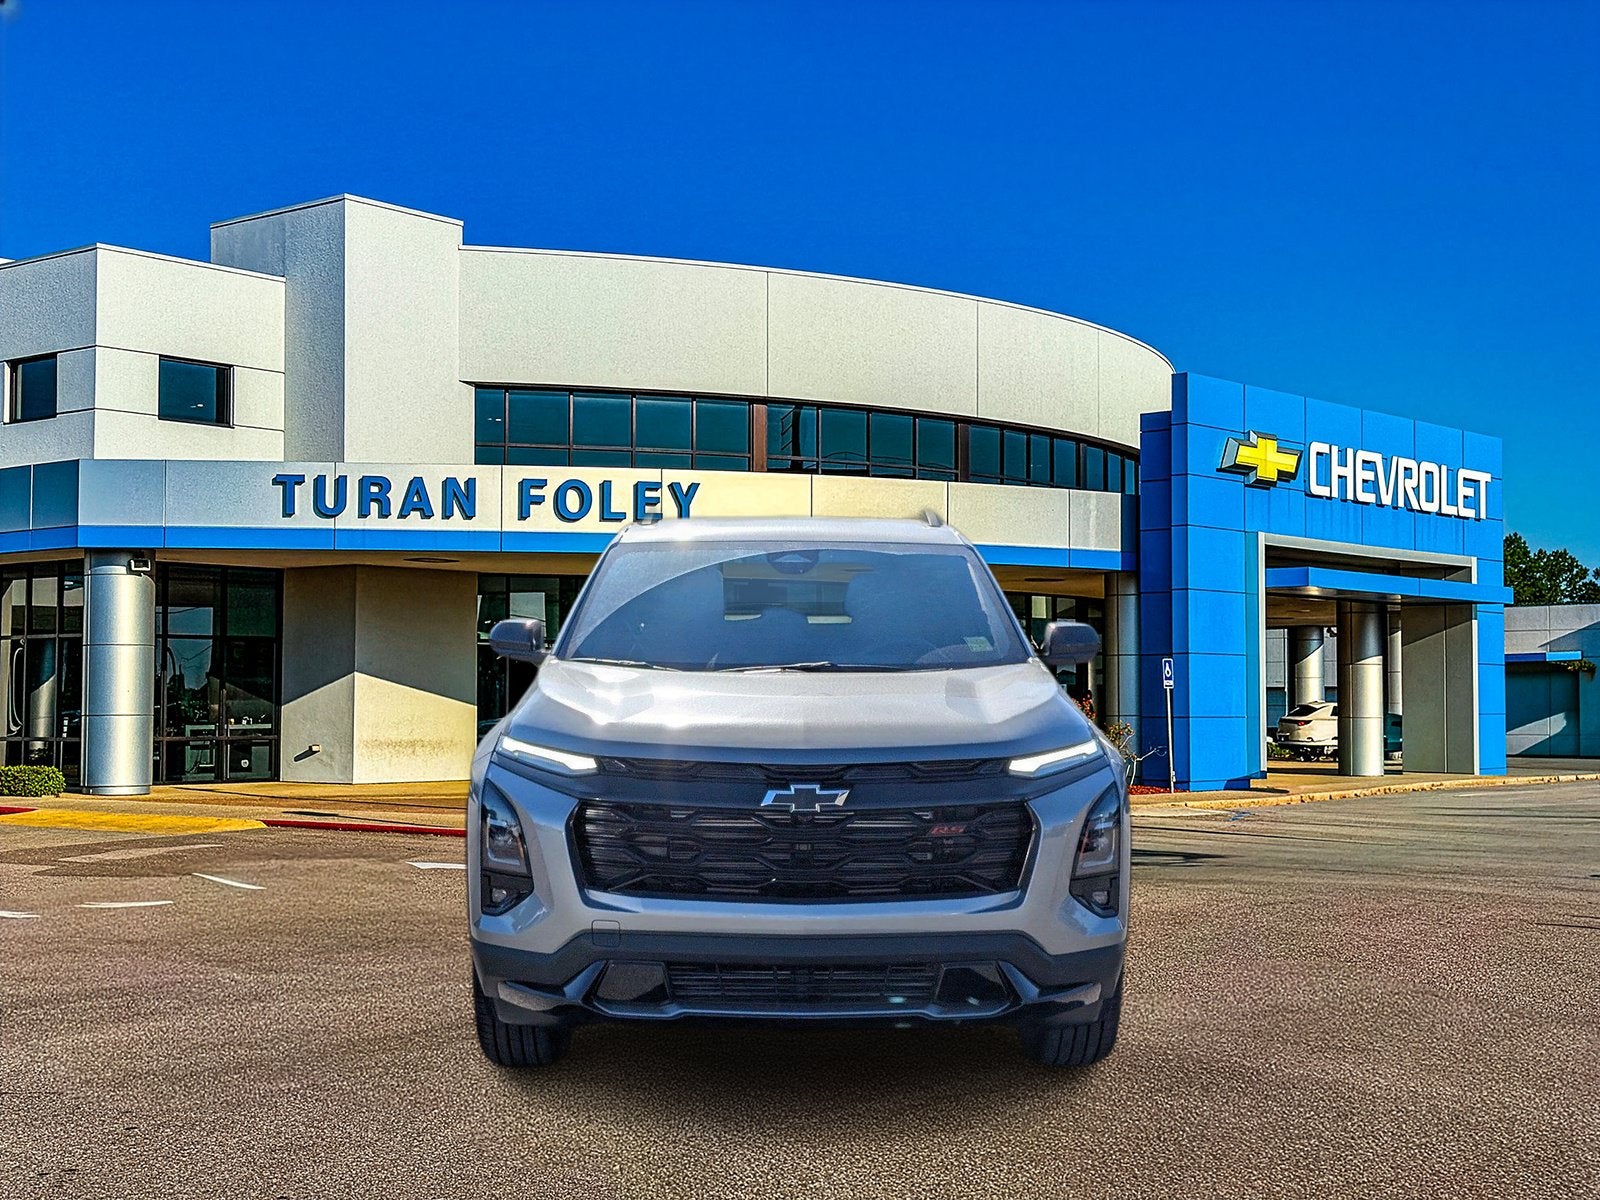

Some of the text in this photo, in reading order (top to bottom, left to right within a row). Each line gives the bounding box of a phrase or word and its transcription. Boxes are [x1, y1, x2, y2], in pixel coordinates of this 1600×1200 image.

[272, 473, 701, 522] TURAN FOLEY
[1307, 441, 1492, 520] CHEVROLET
